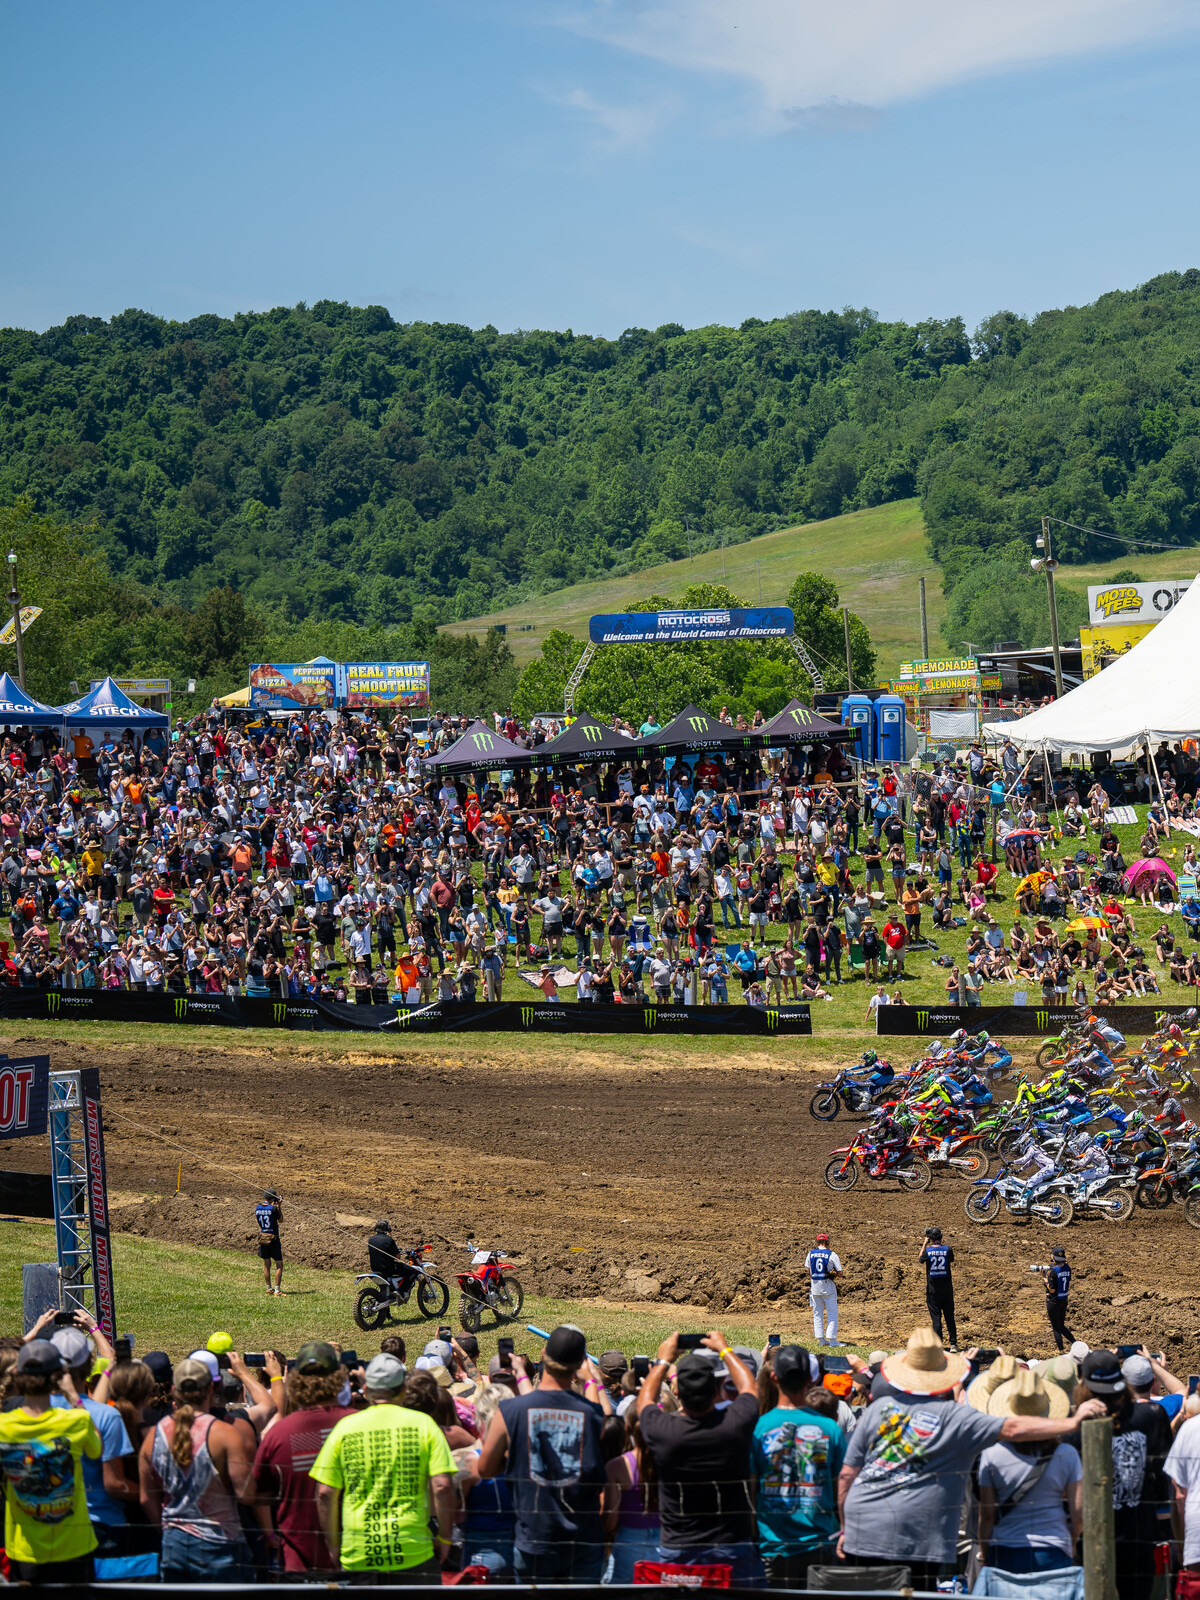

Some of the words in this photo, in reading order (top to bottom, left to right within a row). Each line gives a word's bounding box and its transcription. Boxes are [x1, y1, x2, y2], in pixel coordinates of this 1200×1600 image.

[1096, 587, 1138, 609] MOTO
[1103, 596, 1143, 617] TEES
[658, 614, 730, 626] MOTOCROSS
[603, 633, 643, 641] Welcome
[645, 632, 654, 640] to
[655, 631, 670, 639] the
[671, 630, 698, 638] World
[699, 629, 729, 637] Center
[729, 627, 740, 636] of
[739, 627, 786, 635] Motocross
[293, 666, 334, 676] PEPPERONI
[349, 666, 384, 678] REAL
[387, 664, 427, 677] FRUIT
[914, 658, 976, 673] LEMONADE
[258, 678, 287, 687] PIZZA
[302, 676, 325, 684] ROLLS
[930, 678, 971, 690] LEMONADE
[349, 680, 427, 693] SMOOTHIES
[89, 706, 140, 716] SITECH
[789, 731, 830, 740] MONSTER
[685, 739, 723, 749] MONSTER
[579, 749, 616, 758] MONSTER
[471, 758, 508, 767] MONSTER
[259, 1215, 271, 1229] 13
[815, 1258, 823, 1272] 6
[930, 1256, 946, 1270] 22
[364, 1510, 399, 1521] 2015
[364, 1522, 399, 1533] 2016
[364, 1532, 400, 1544] 2017
[364, 1543, 402, 1556] 2018
[366, 1555, 404, 1567] 2019
[661, 1572, 705, 1584] Academy
